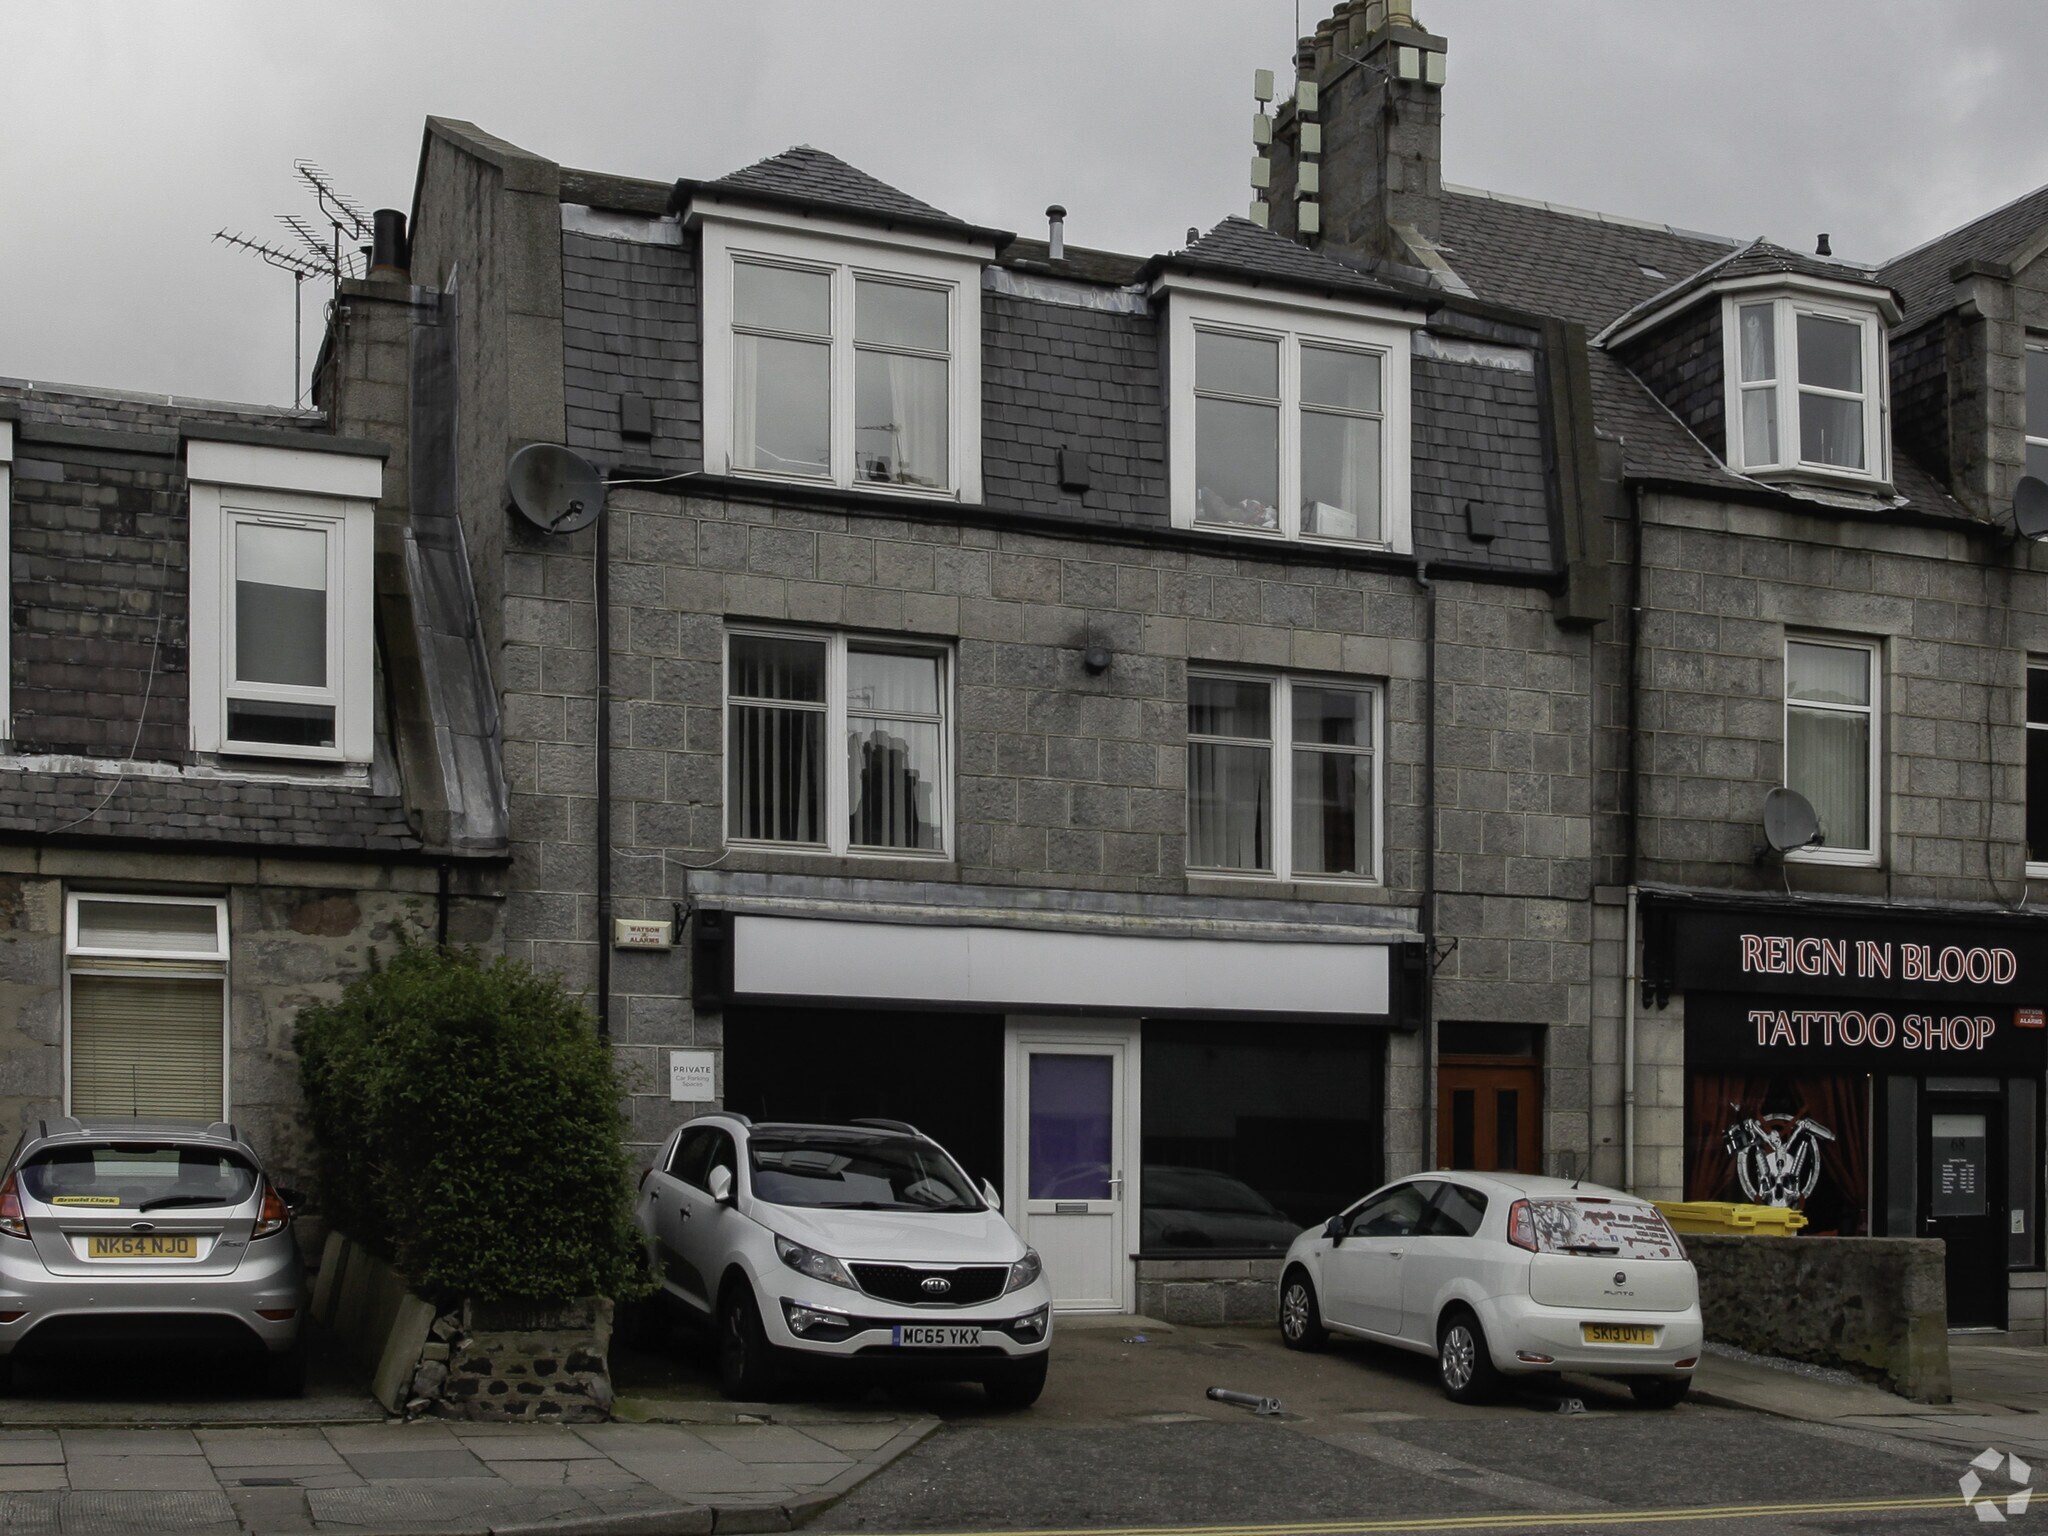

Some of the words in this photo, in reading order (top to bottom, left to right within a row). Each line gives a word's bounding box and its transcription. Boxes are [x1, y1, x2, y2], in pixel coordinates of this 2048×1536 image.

[1740, 934, 1847, 977] REIGN
[1856, 940, 1892, 979] IN
[1901, 943, 2017, 985] BLOOD
[1748, 1010, 1896, 1048] TATTOO
[1903, 1014, 1996, 1051] SHOP
[673, 1066, 711, 1074] PRIVATE
[96, 1239, 145, 1254] NK64
[927, 1281, 947, 1290] KIA
[903, 1328, 945, 1344] MC65
[950, 1329, 979, 1345] YKX
[1592, 1327, 1621, 1340] SK13
